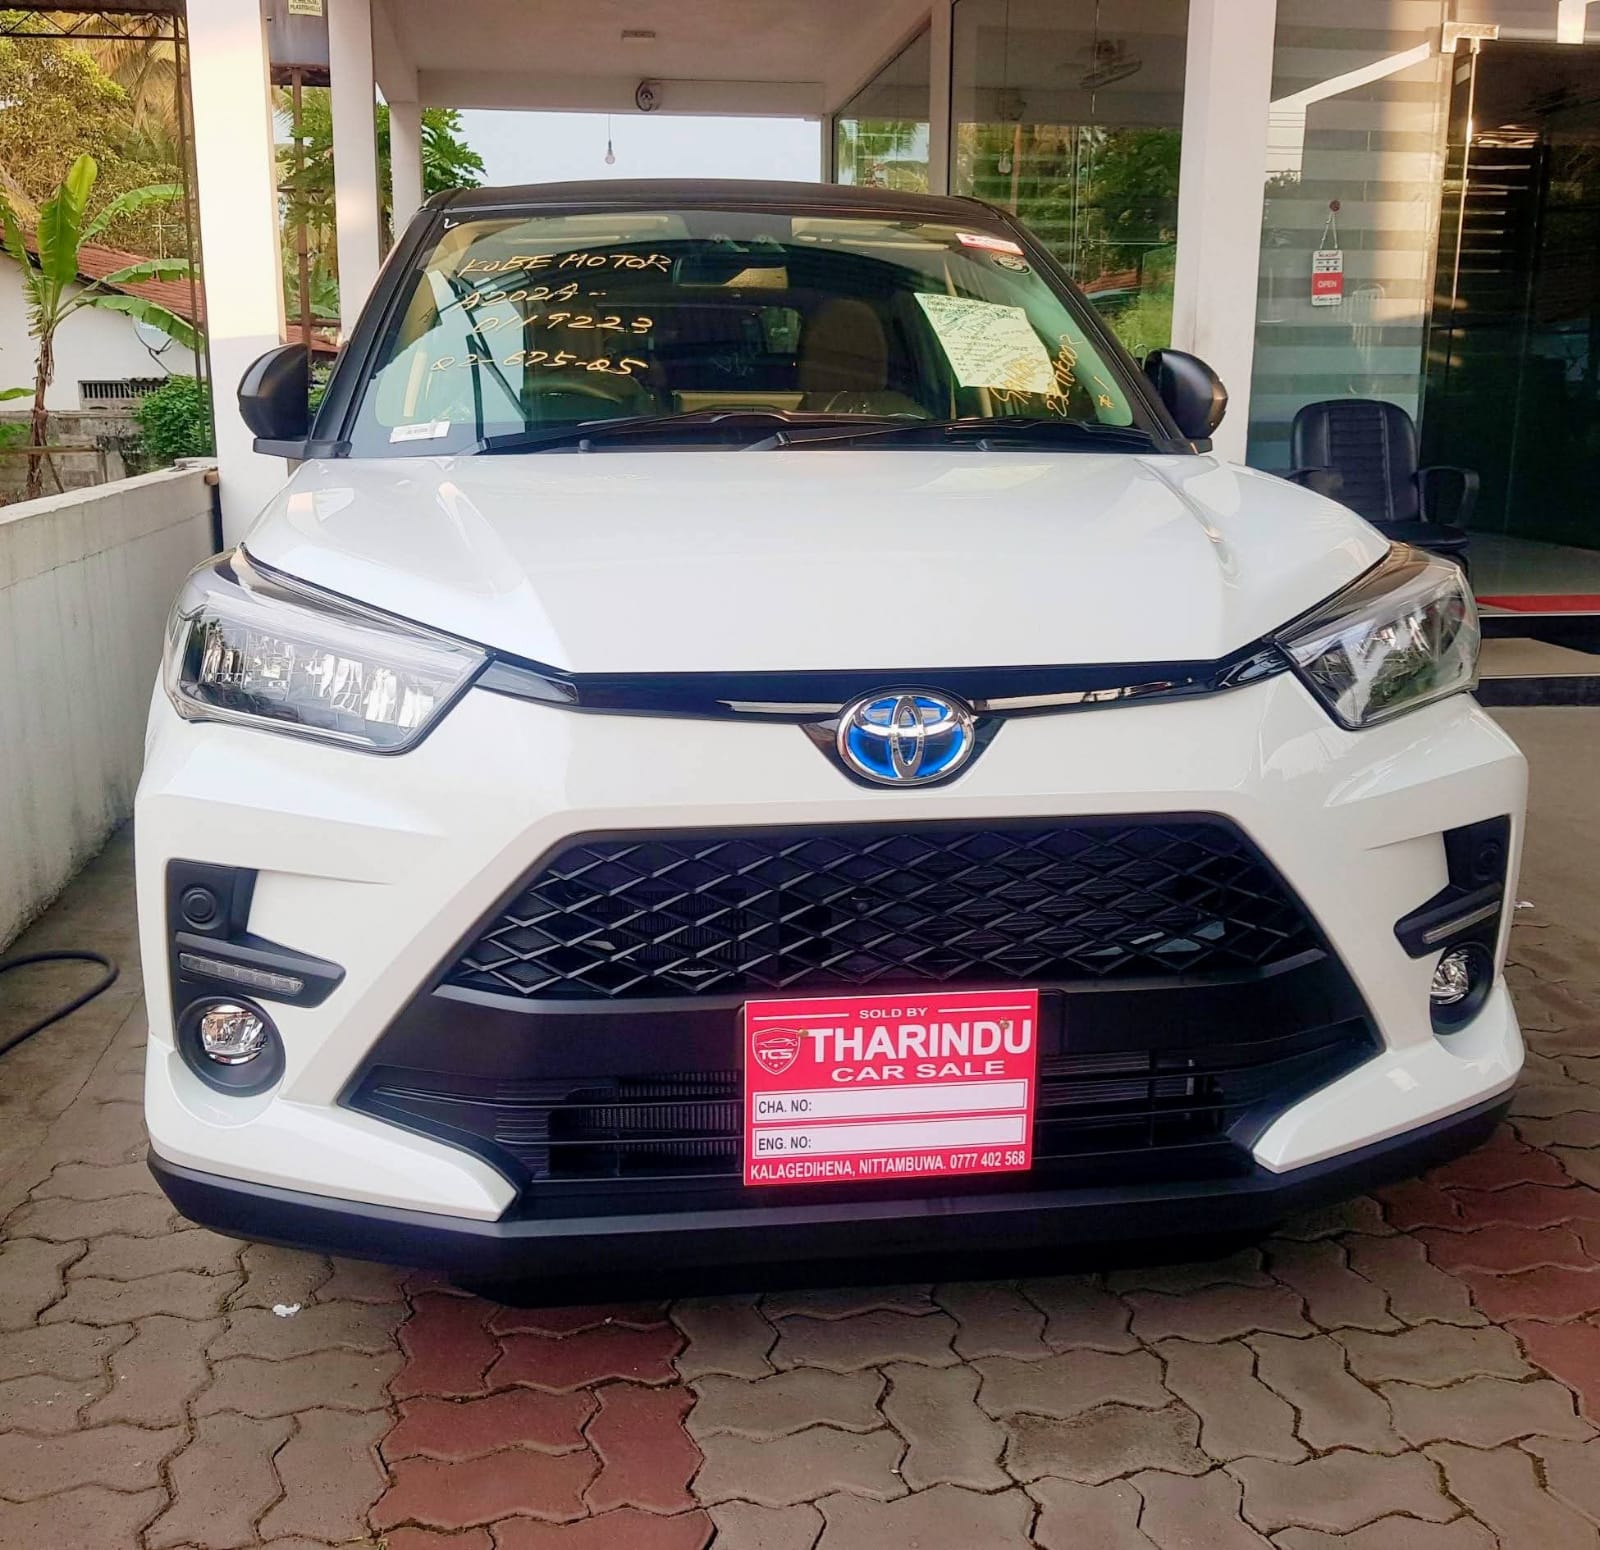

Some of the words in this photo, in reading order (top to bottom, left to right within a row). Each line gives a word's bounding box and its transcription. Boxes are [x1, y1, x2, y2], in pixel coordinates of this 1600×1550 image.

[457, 253, 557, 278] KOBE
[559, 253, 672, 273] MOTOR
[859, 1008, 902, 1019] SOLD
[907, 1007, 928, 1017] BY
[803, 1019, 1032, 1063] THARINDU
[758, 1048, 794, 1060] TCS
[831, 1065, 905, 1082] CAR
[916, 1060, 1005, 1078] SALE
[758, 1099, 787, 1114] CHA.
[790, 1099, 812, 1112] NO:
[758, 1137, 787, 1151] ENG.
[790, 1136, 812, 1149] NO:
[751, 1160, 856, 1180] KALAGEDIHENA,
[950, 1153, 977, 1169] 0777
[981, 1152, 1001, 1167] 402
[1005, 1150, 1025, 1166] 568
